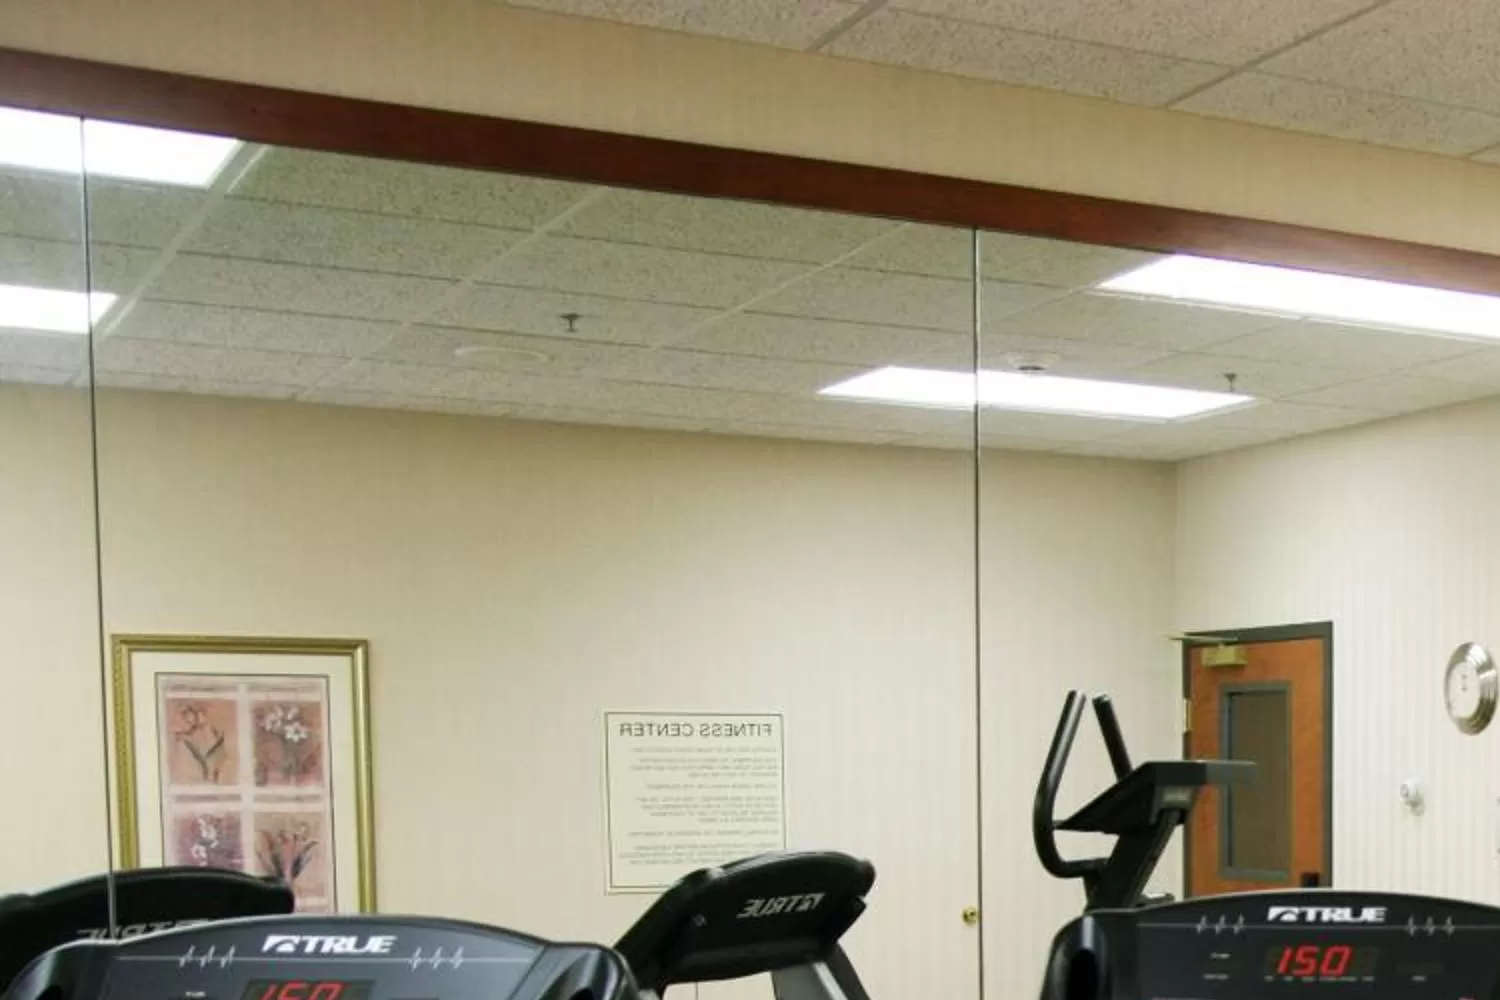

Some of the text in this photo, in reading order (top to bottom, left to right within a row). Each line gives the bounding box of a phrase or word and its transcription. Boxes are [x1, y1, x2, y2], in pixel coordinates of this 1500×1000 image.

[1300, 906, 1388, 922] TRUE
[302, 934, 398, 954] TRUE
[1277, 945, 1353, 977] 150
